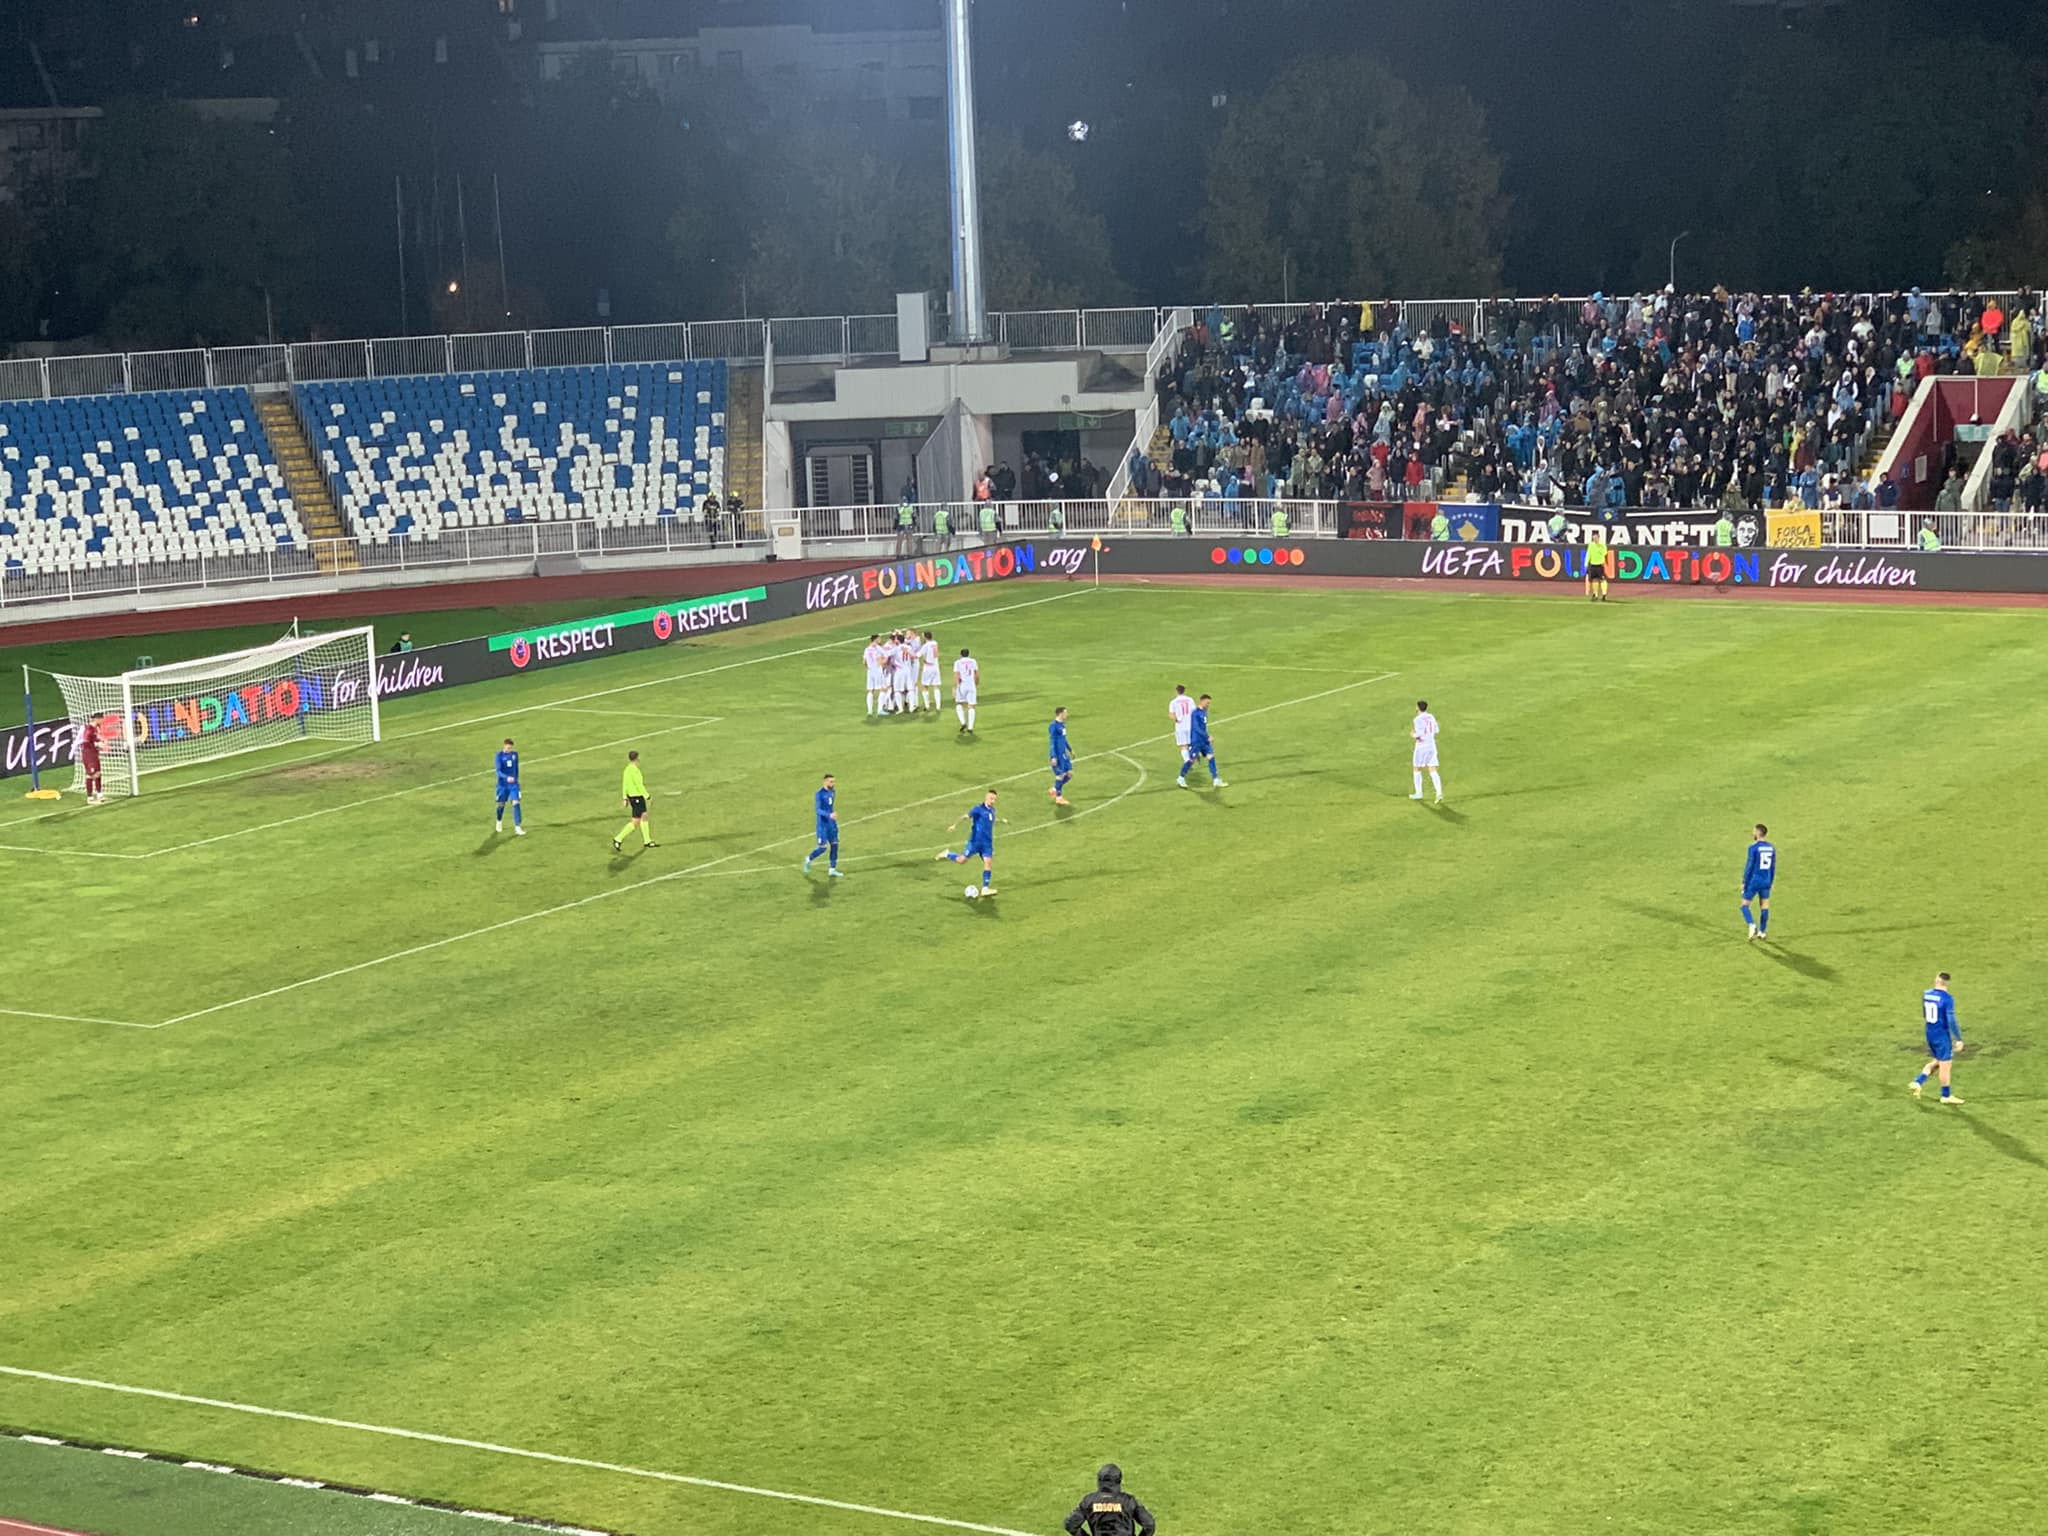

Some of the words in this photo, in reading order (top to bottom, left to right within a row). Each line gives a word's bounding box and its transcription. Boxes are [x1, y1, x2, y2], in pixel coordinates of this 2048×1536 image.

[806, 575, 859, 609] UEFA
[861, 543, 1034, 600] FOUNDATION
[1039, 547, 1087, 574] .org
[1422, 546, 1504, 576] UEFA
[1769, 553, 1807, 586] for
[1814, 556, 1917, 586] children
[677, 597, 750, 633] RESPECT
[536, 622, 616, 660] RESPECT
[331, 670, 361, 710] for
